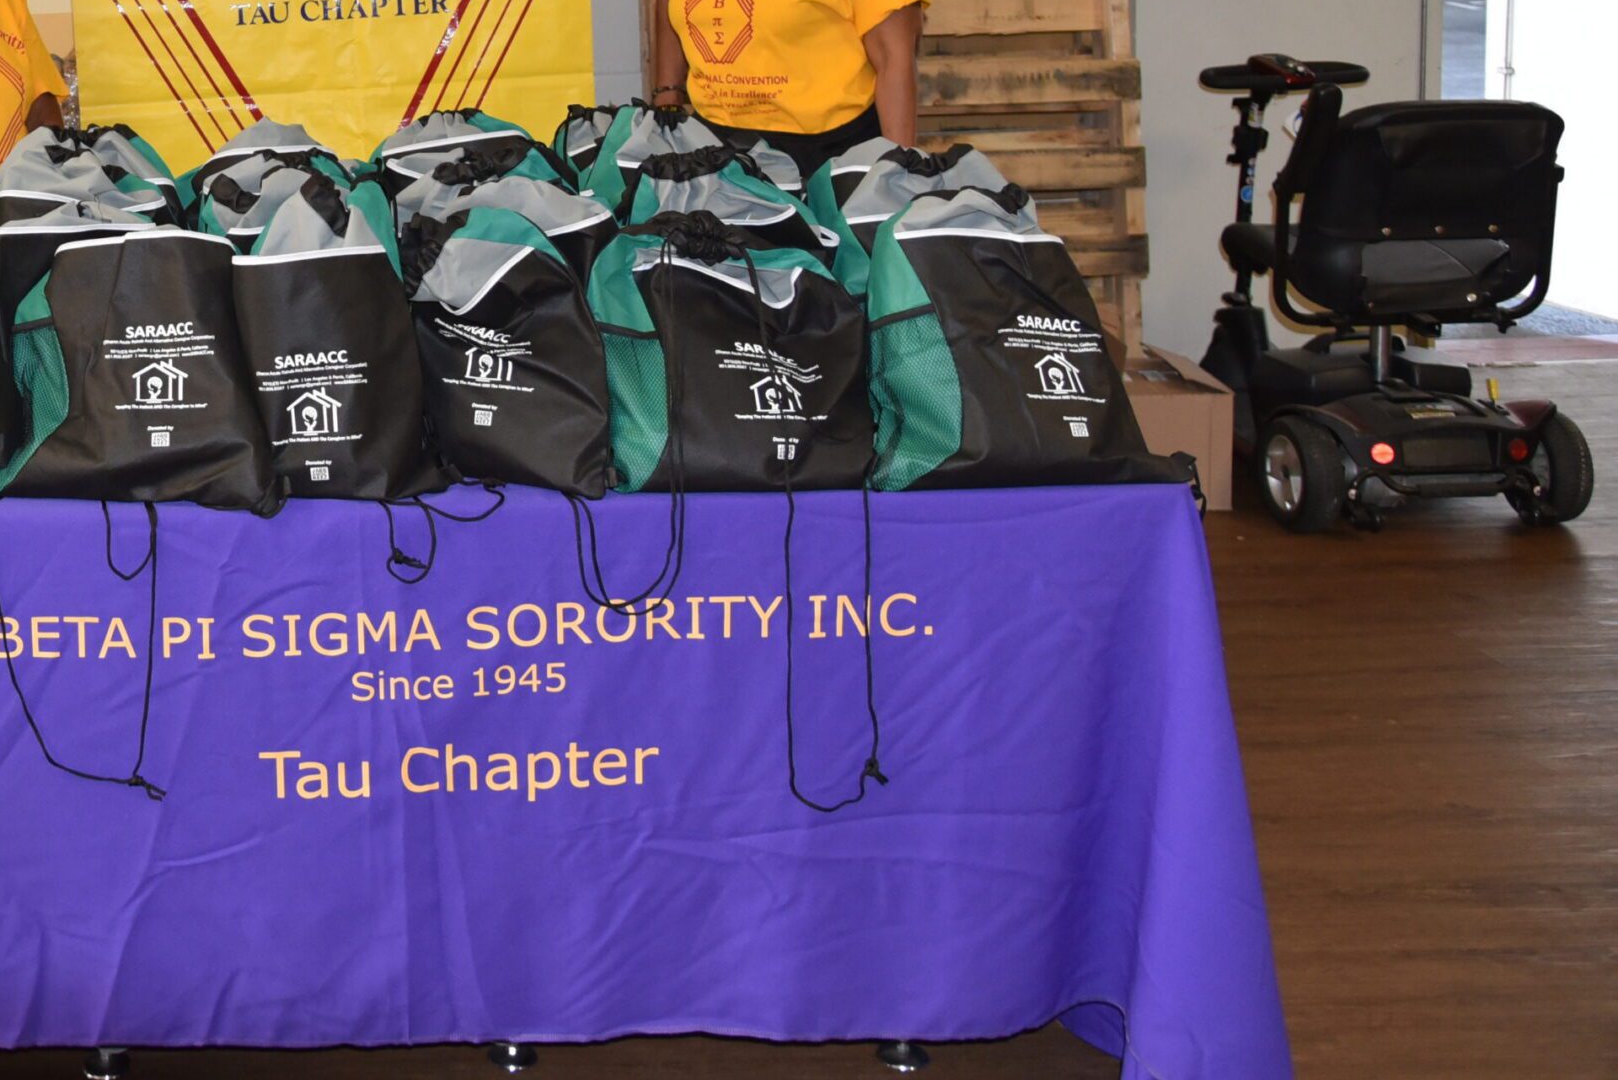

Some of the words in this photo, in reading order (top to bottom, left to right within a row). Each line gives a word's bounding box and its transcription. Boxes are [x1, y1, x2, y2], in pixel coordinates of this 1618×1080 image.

[231, 1, 290, 26] TAU
[725, 74, 789, 86] CONVENTION
[125, 322, 193, 339] SARAACC
[1016, 315, 1081, 332] SARAACC
[274, 349, 348, 369] SARAACC
[162, 616, 216, 660] PI
[241, 608, 441, 658] SIGMA
[465, 595, 783, 650] SORORITY
[808, 593, 935, 639] INC.
[350, 668, 455, 702] Since
[472, 662, 567, 698] 1945
[258, 750, 371, 799] Tau
[400, 741, 660, 801] Chapter
